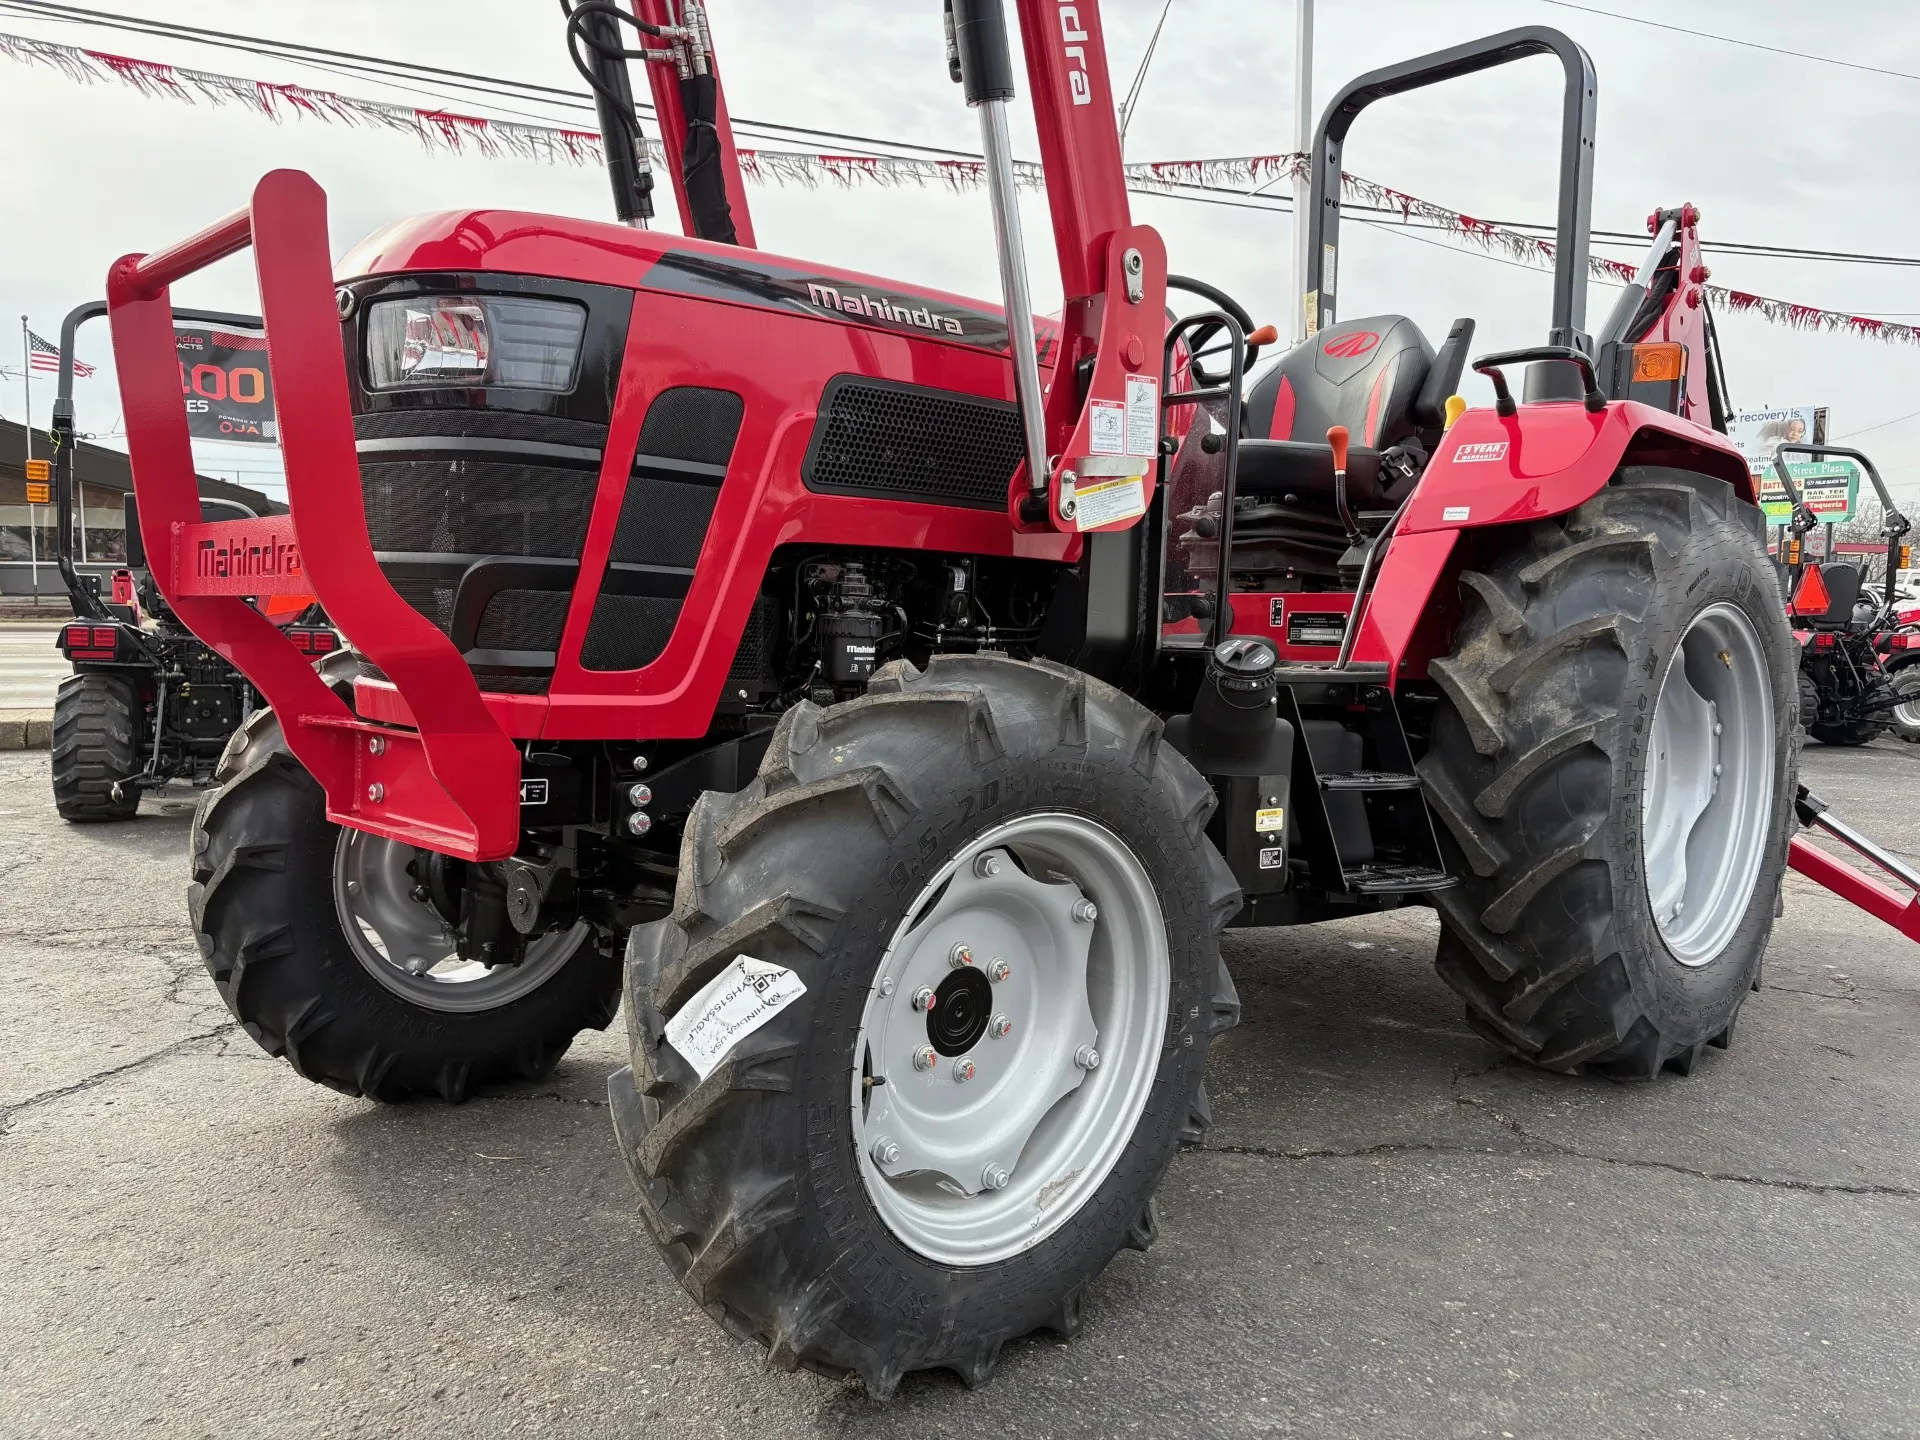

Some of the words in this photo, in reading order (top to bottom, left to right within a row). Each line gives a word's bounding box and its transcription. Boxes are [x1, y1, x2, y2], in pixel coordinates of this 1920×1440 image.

[1057, 0, 1092, 106] dra
[807, 282, 964, 336] Mahindra
[184, 399, 209, 413] ES
[218, 415, 248, 424] POWERED
[1740, 411, 1788, 422] recovery
[1790, 408, 1803, 418] is.
[219, 421, 260, 435] OJA
[1464, 446, 1471, 454] 5
[1474, 444, 1501, 453] YEAR
[1462, 453, 1497, 461] WARRANTY
[1793, 466, 1817, 476] Street
[1821, 462, 1845, 473] Plaza
[1763, 480, 1802, 490] BATTES
[198, 534, 301, 577] Mahindra
[888, 779, 1000, 897] 9.5-20
[726, 991, 782, 1036] MAHINDRA
[709, 1035, 729, 1055] USA
